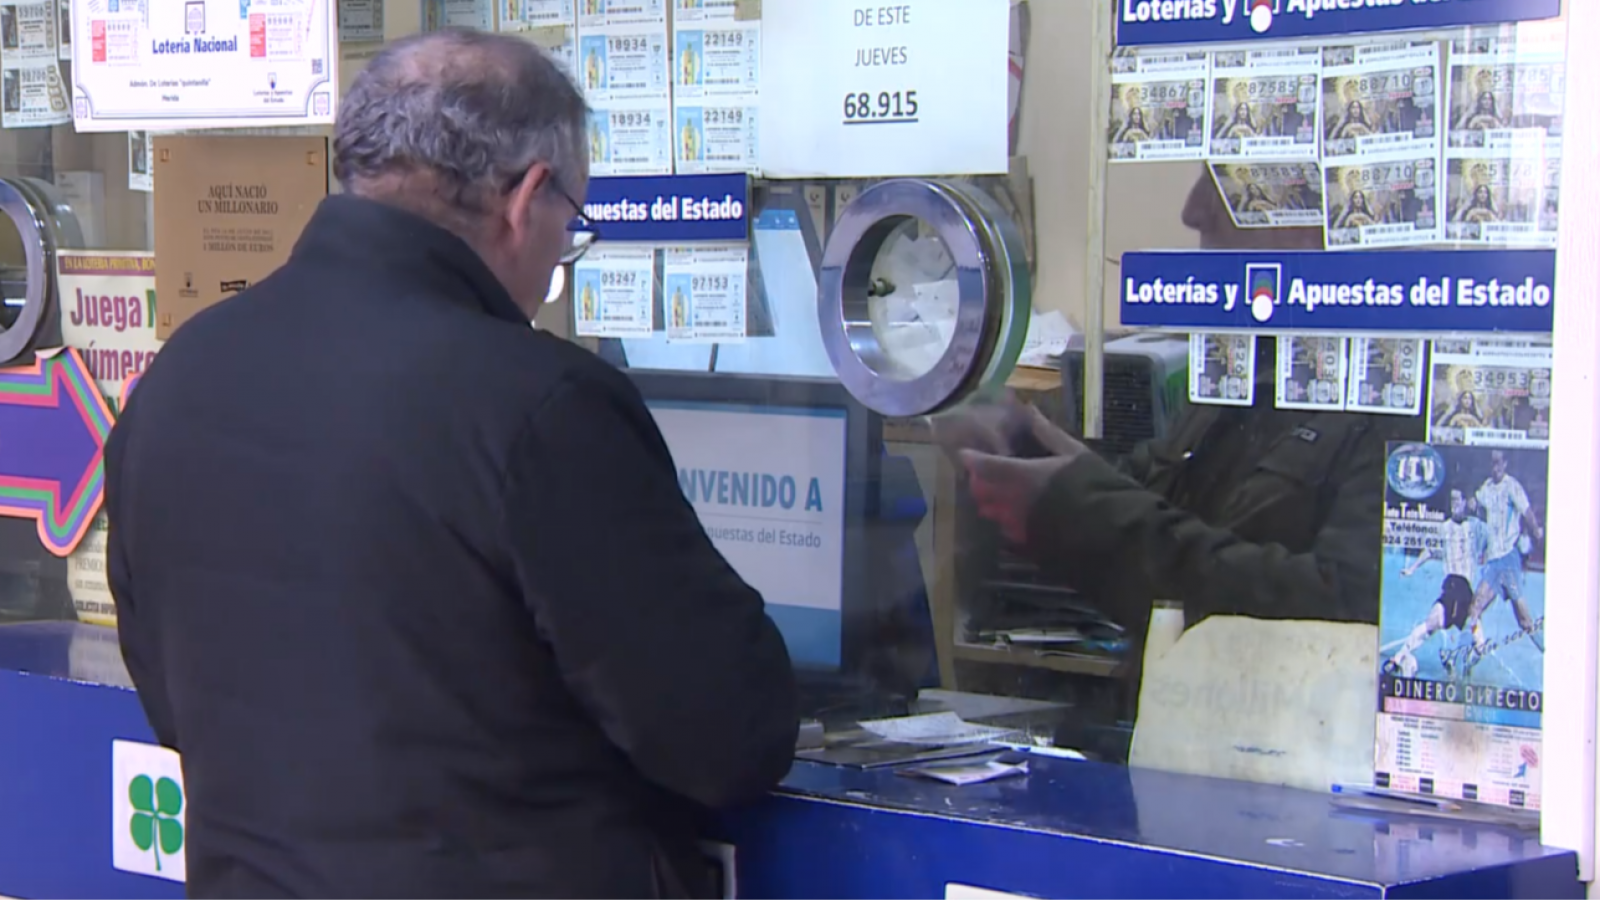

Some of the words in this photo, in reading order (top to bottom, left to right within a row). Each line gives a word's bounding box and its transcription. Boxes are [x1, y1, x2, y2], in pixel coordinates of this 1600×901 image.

[854, 8, 873, 26] DE
[878, 6, 911, 25] ESTE
[1222, 0, 1236, 24] y
[194, 35, 238, 52] Nacional
[608, 38, 647, 52] 18934
[704, 32, 743, 46] 22149
[855, 46, 907, 66] JUEVES
[1359, 74, 1411, 91] 88710
[1140, 86, 1186, 100] 34867
[843, 90, 918, 119] 68.915
[611, 112, 650, 127] 18934
[704, 109, 743, 123] 22149
[208, 183, 233, 200] AQUÍ
[198, 201, 212, 213] UN
[214, 201, 278, 214] MILLONARIO
[651, 196, 677, 220] del
[681, 195, 743, 220] Estado
[602, 271, 636, 286] 05247
[692, 277, 728, 290] 97153
[1126, 276, 1219, 303] Loterías
[1224, 283, 1238, 311] y
[1288, 278, 1403, 311] Apuestas
[1410, 278, 1449, 306] del
[1457, 277, 1550, 306] Estado
[70, 288, 142, 332] Juega
[805, 477, 823, 512] A
[757, 527, 776, 544] del
[780, 530, 821, 548] Estado
[1394, 679, 1457, 702] DINERO
[1465, 685, 1540, 710] DIRECTO
